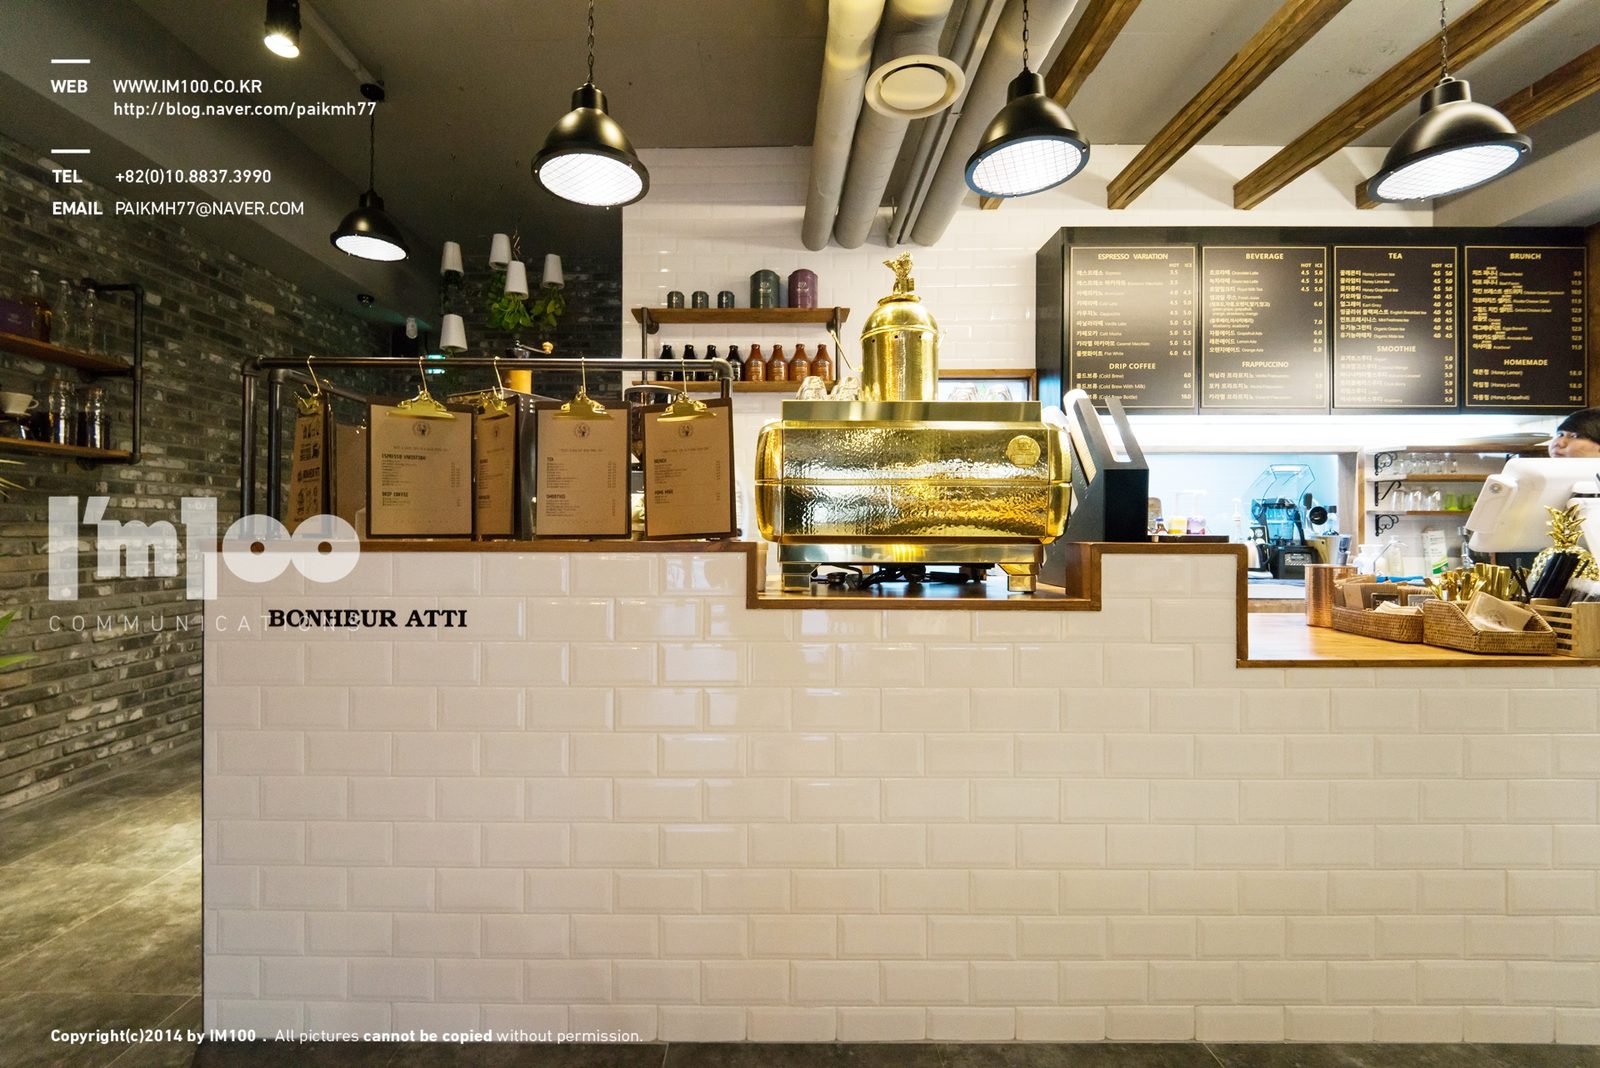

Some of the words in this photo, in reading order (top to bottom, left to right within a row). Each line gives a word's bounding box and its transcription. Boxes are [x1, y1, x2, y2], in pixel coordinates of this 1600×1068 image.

[1388, 252, 1403, 260] TEA
[268, 609, 398, 628] BONHEUR
[404, 609, 468, 628] ATTI
